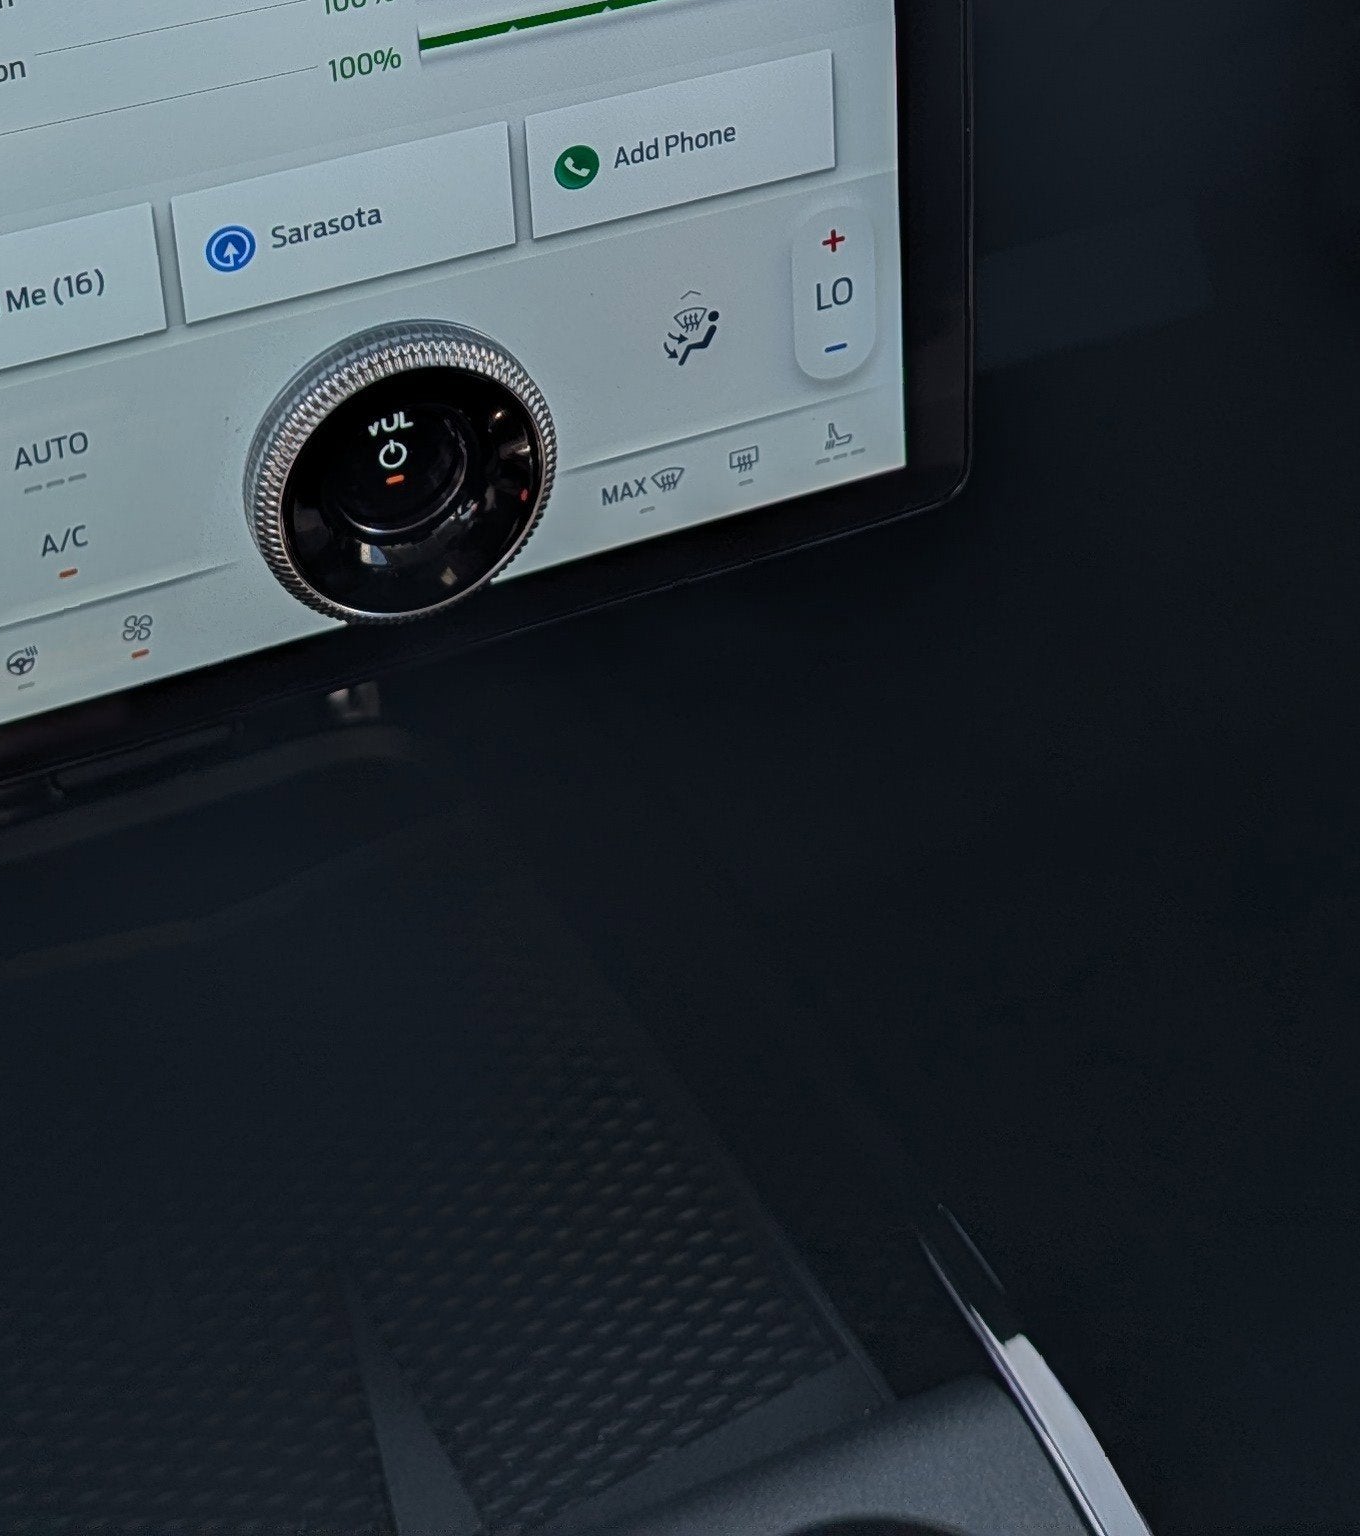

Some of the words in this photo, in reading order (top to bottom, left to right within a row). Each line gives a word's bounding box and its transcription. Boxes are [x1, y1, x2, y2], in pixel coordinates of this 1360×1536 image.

[329, 48, 401, 81] 100%
[615, 138, 660, 168] Add
[665, 127, 736, 156] Phone
[271, 208, 382, 248] Sarasota
[6, 287, 45, 311] Me
[53, 269, 104, 305] (16)
[816, 277, 853, 311] LO
[15, 432, 88, 470] AUTO
[602, 478, 647, 505] MAX
[42, 525, 87, 557] A/C
